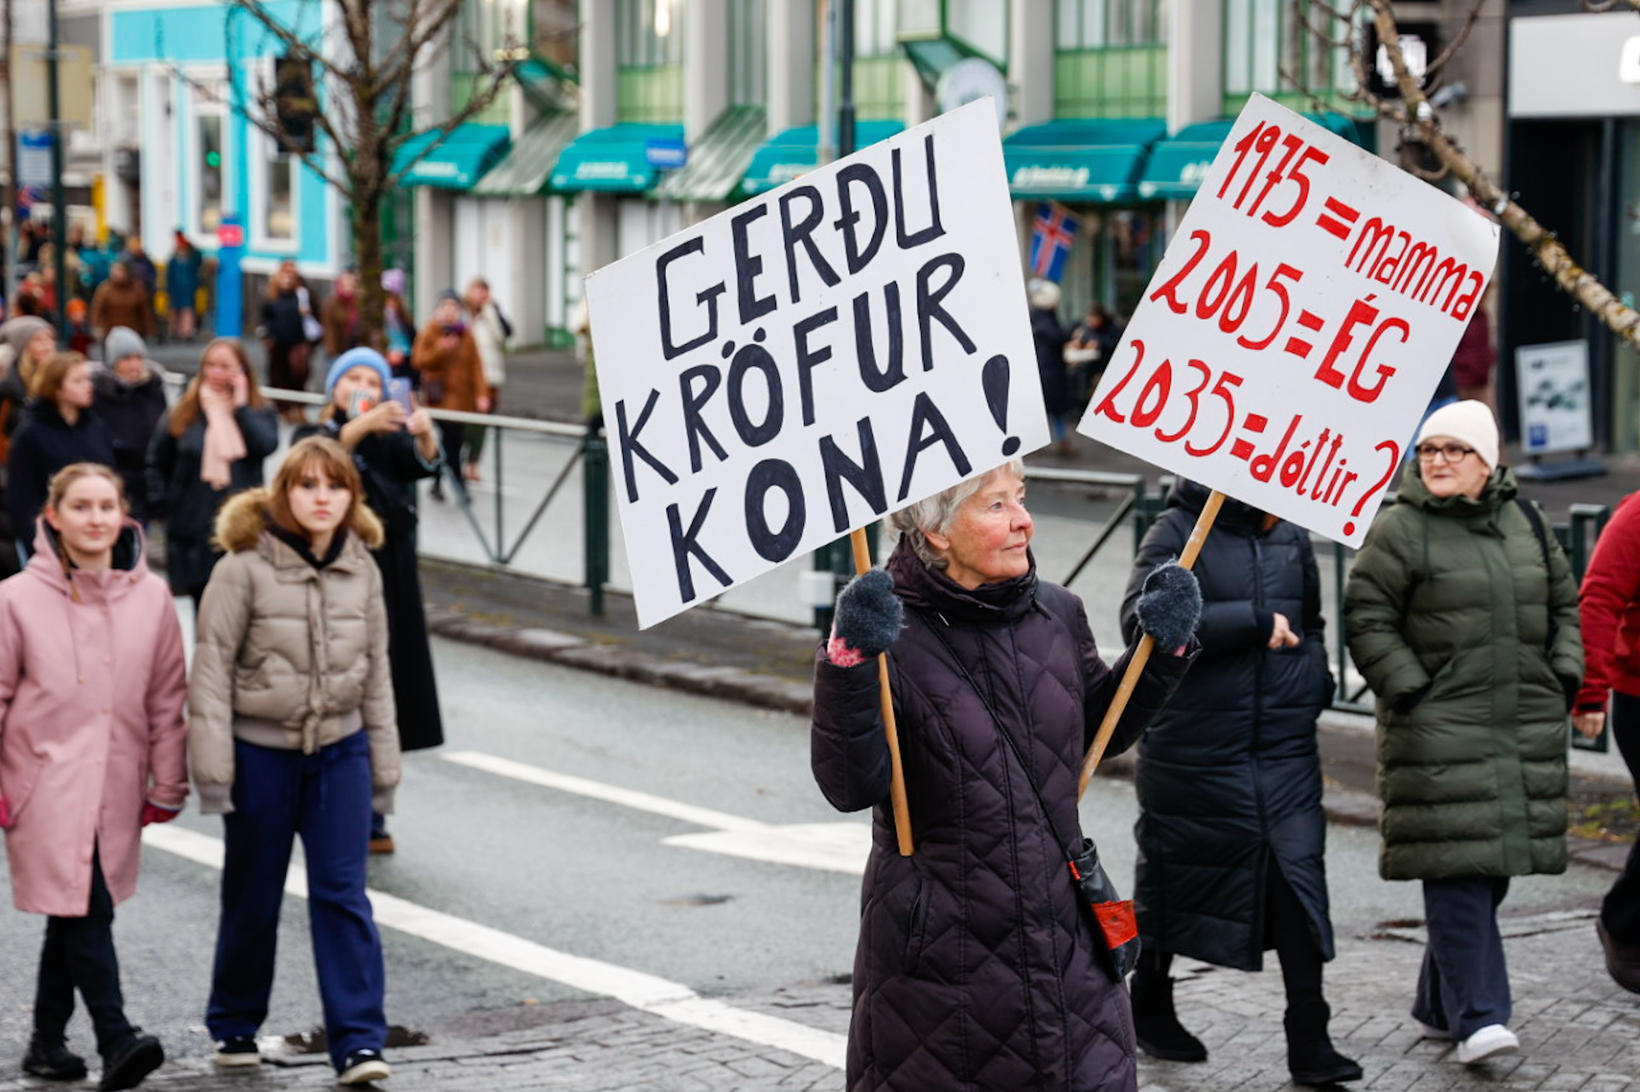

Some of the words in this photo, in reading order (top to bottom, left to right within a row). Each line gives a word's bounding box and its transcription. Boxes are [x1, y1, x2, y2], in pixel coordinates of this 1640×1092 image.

[656, 134, 947, 361] GERÐU
[615, 252, 977, 504] KRÖFUR
[665, 354, 1021, 604] KONA!
